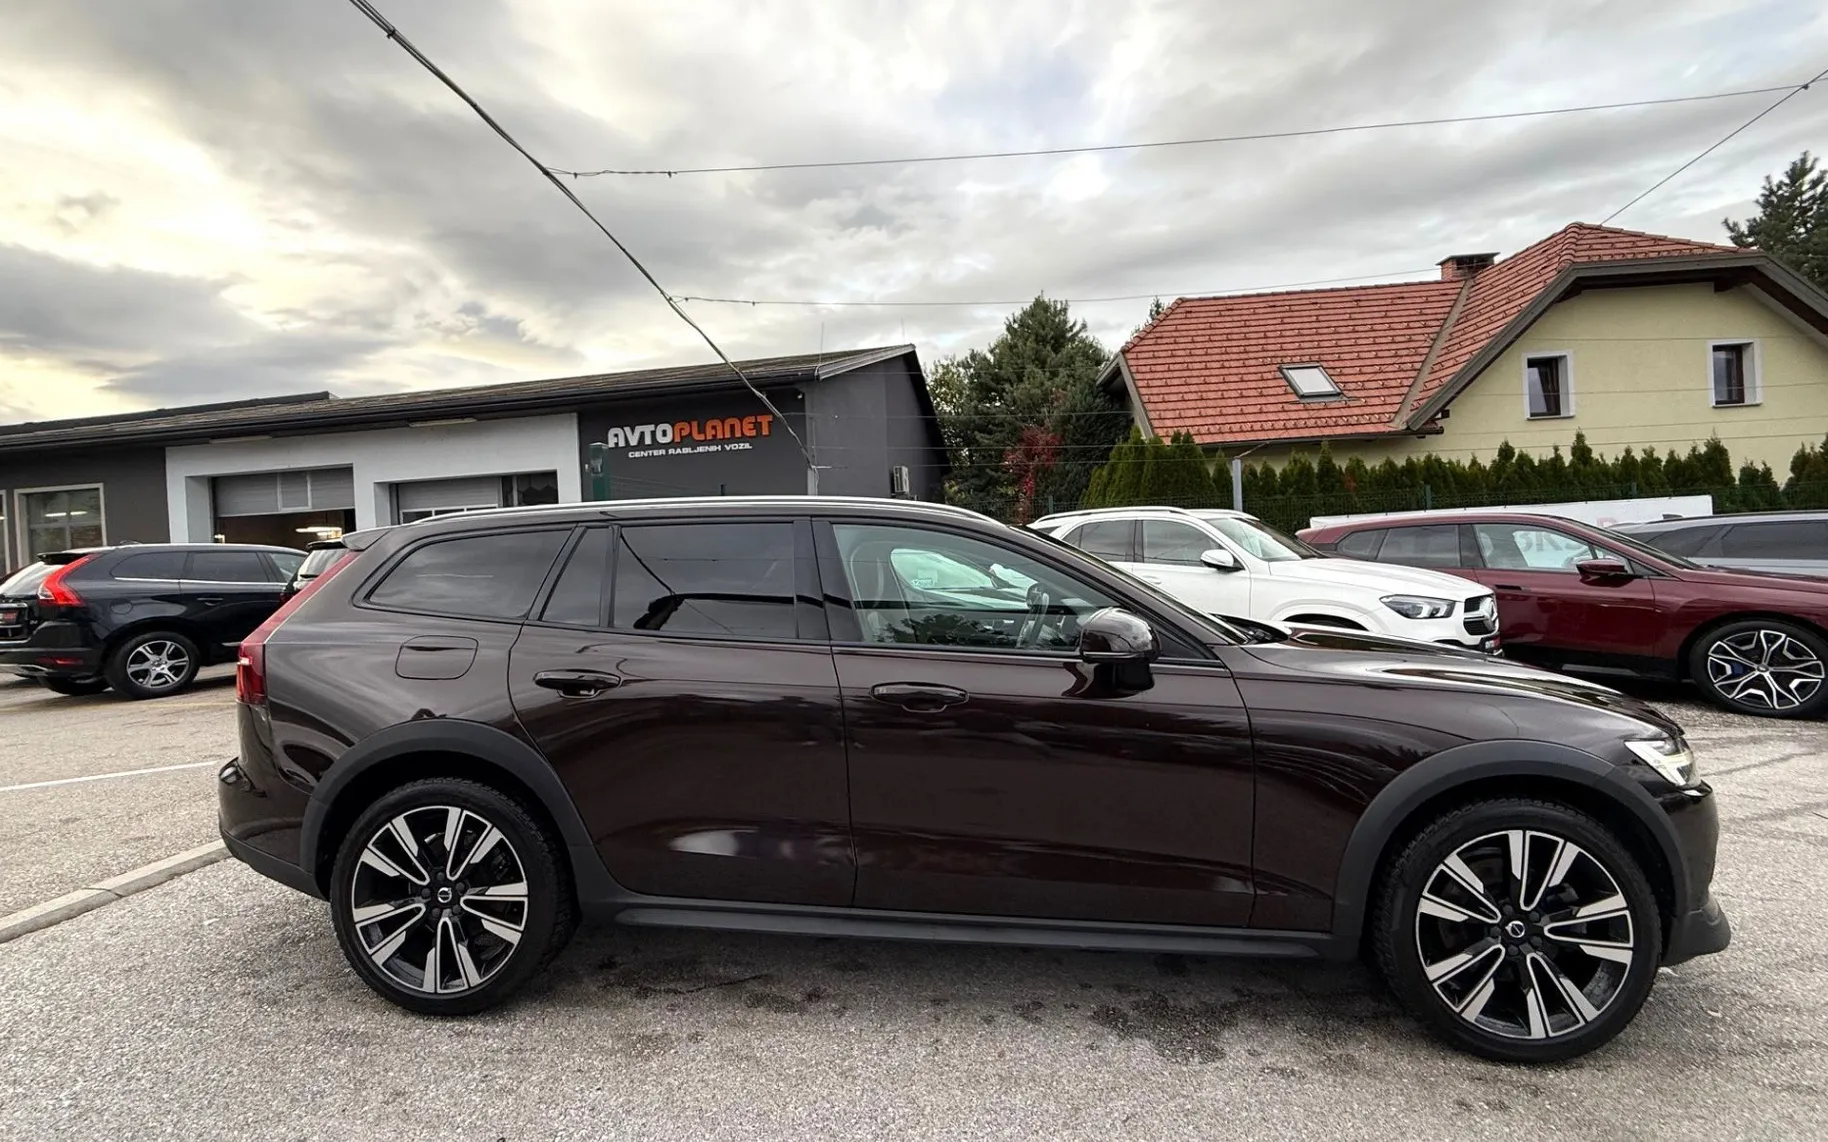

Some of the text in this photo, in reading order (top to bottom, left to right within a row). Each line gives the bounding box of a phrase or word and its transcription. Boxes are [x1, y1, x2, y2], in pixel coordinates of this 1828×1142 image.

[607, 415, 773, 448] AVTOPLANET
[628, 449, 666, 458] CENTER
[668, 445, 721, 455] RABLJENIH
